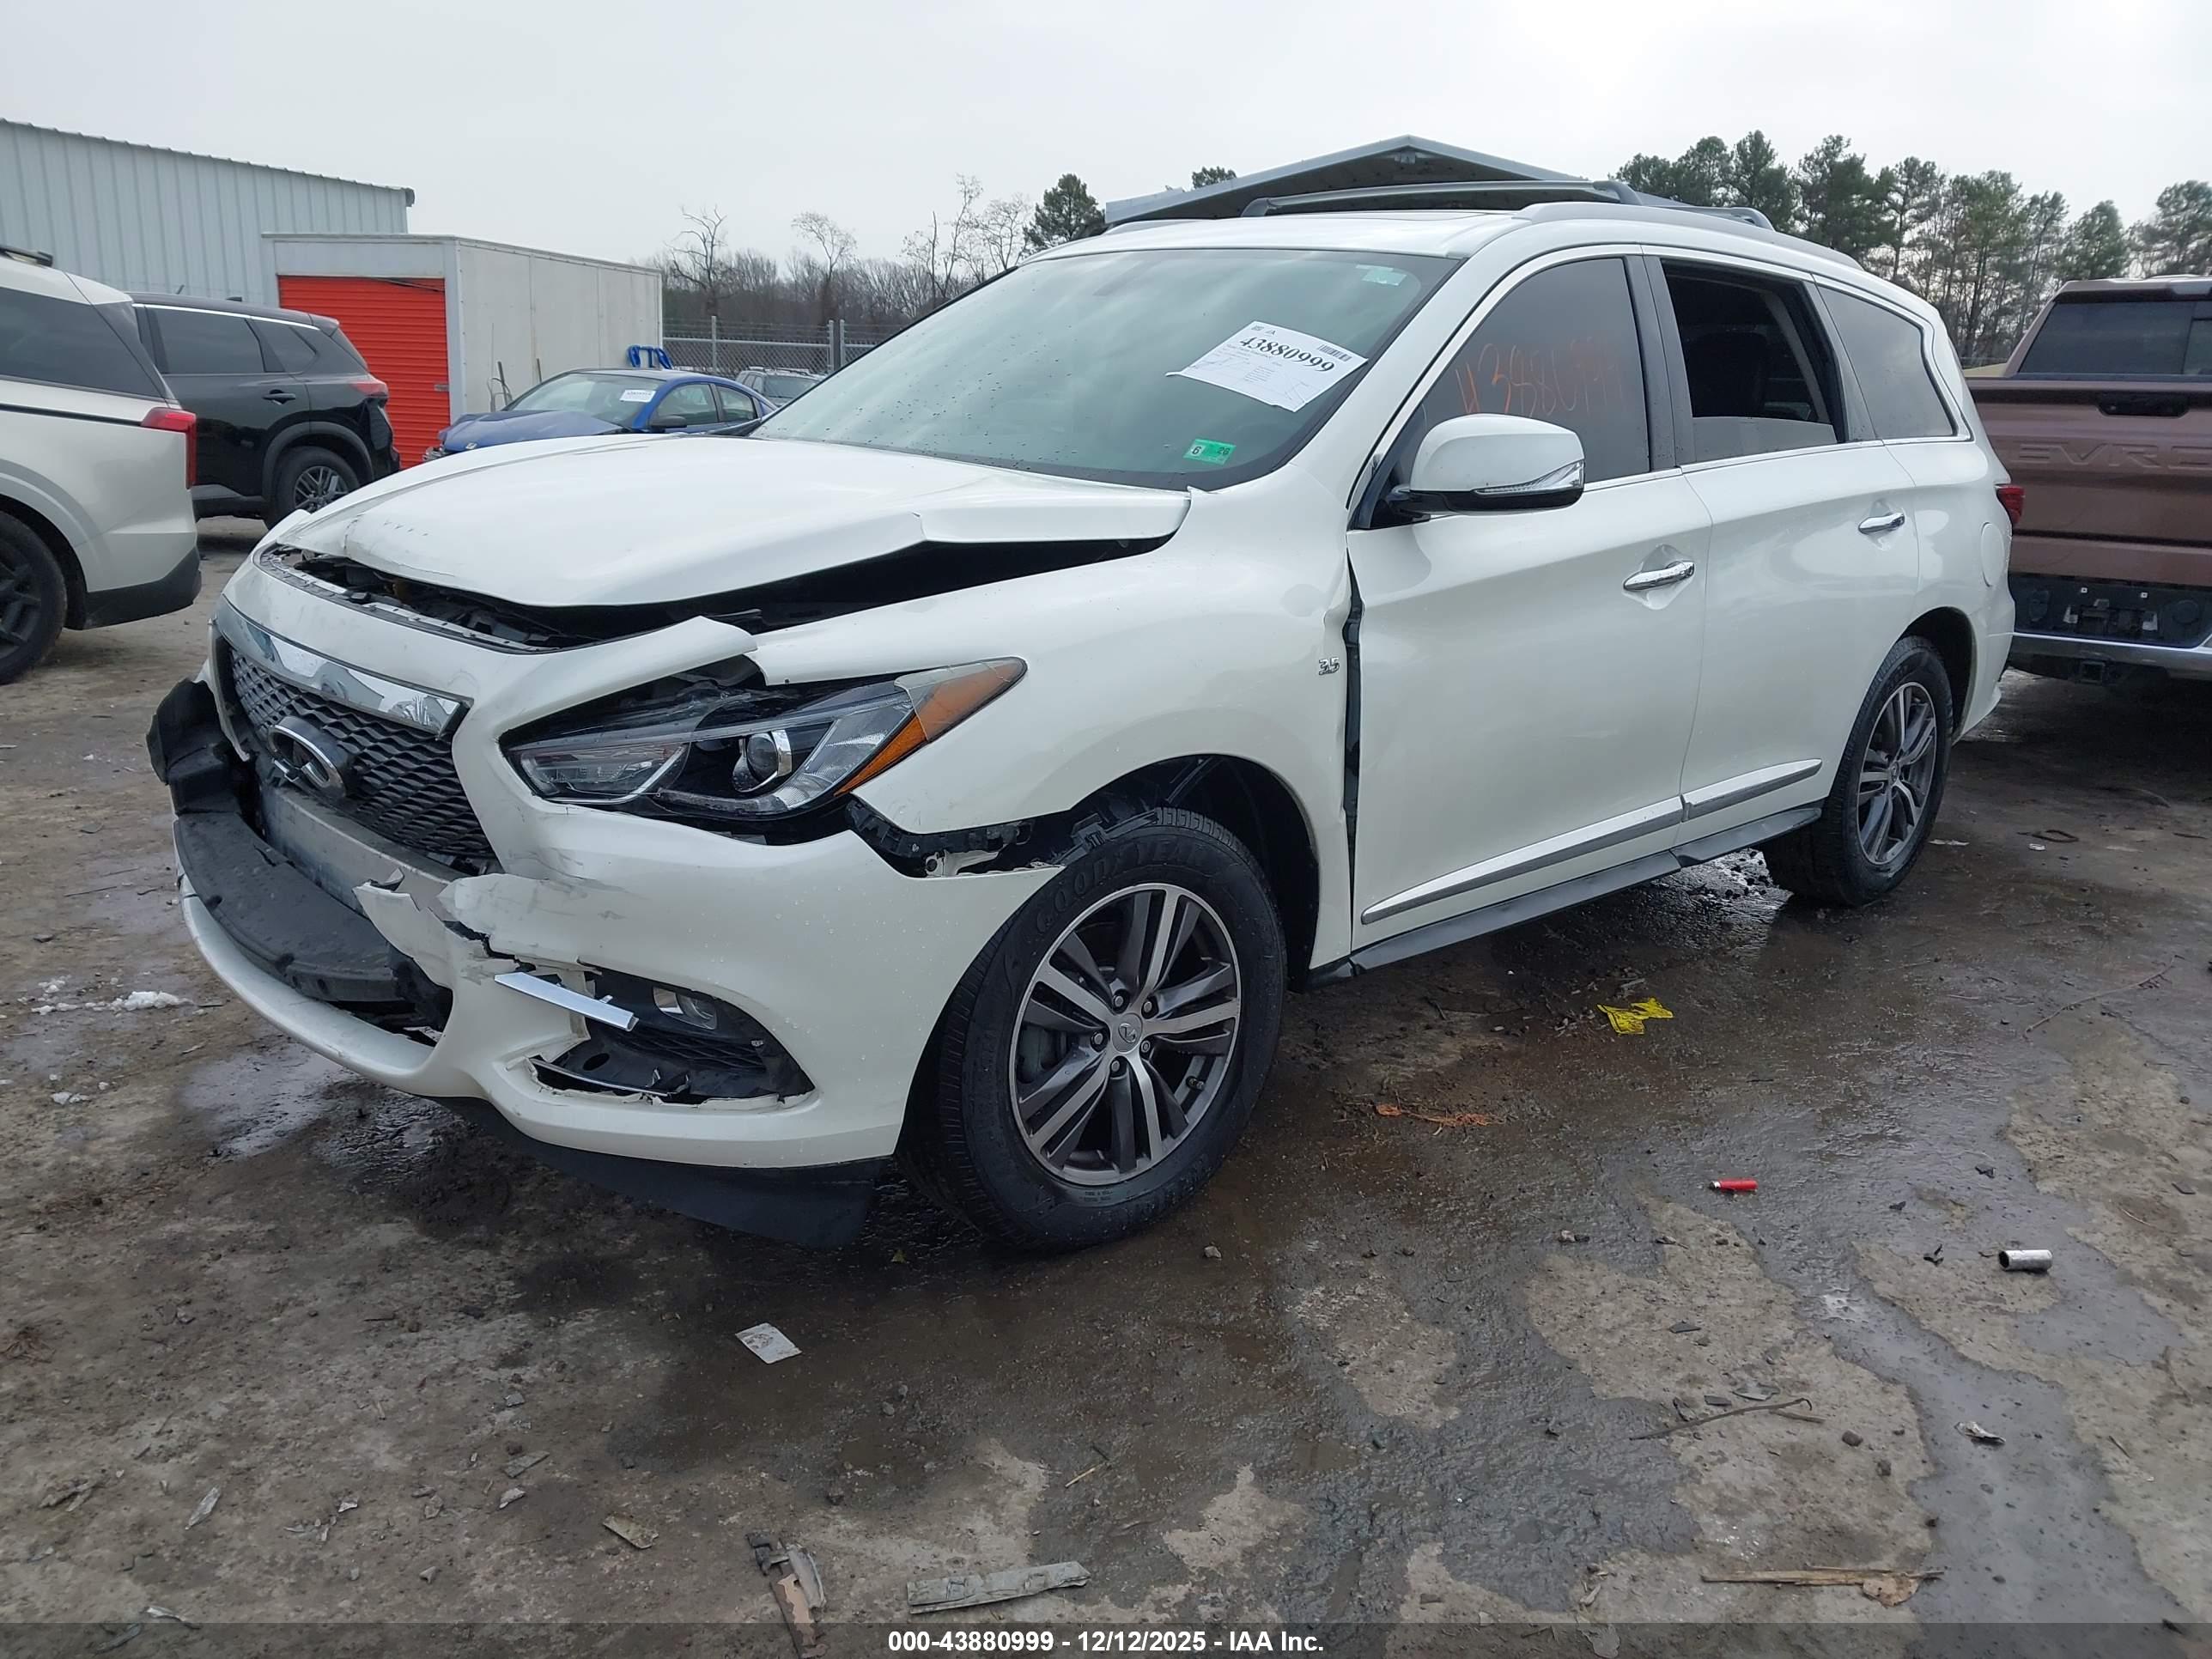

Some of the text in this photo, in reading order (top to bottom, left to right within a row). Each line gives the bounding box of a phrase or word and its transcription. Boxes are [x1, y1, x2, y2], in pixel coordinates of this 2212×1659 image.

[1239, 336, 1335, 373] 43880999
[1191, 446, 1231, 456] 6 26
